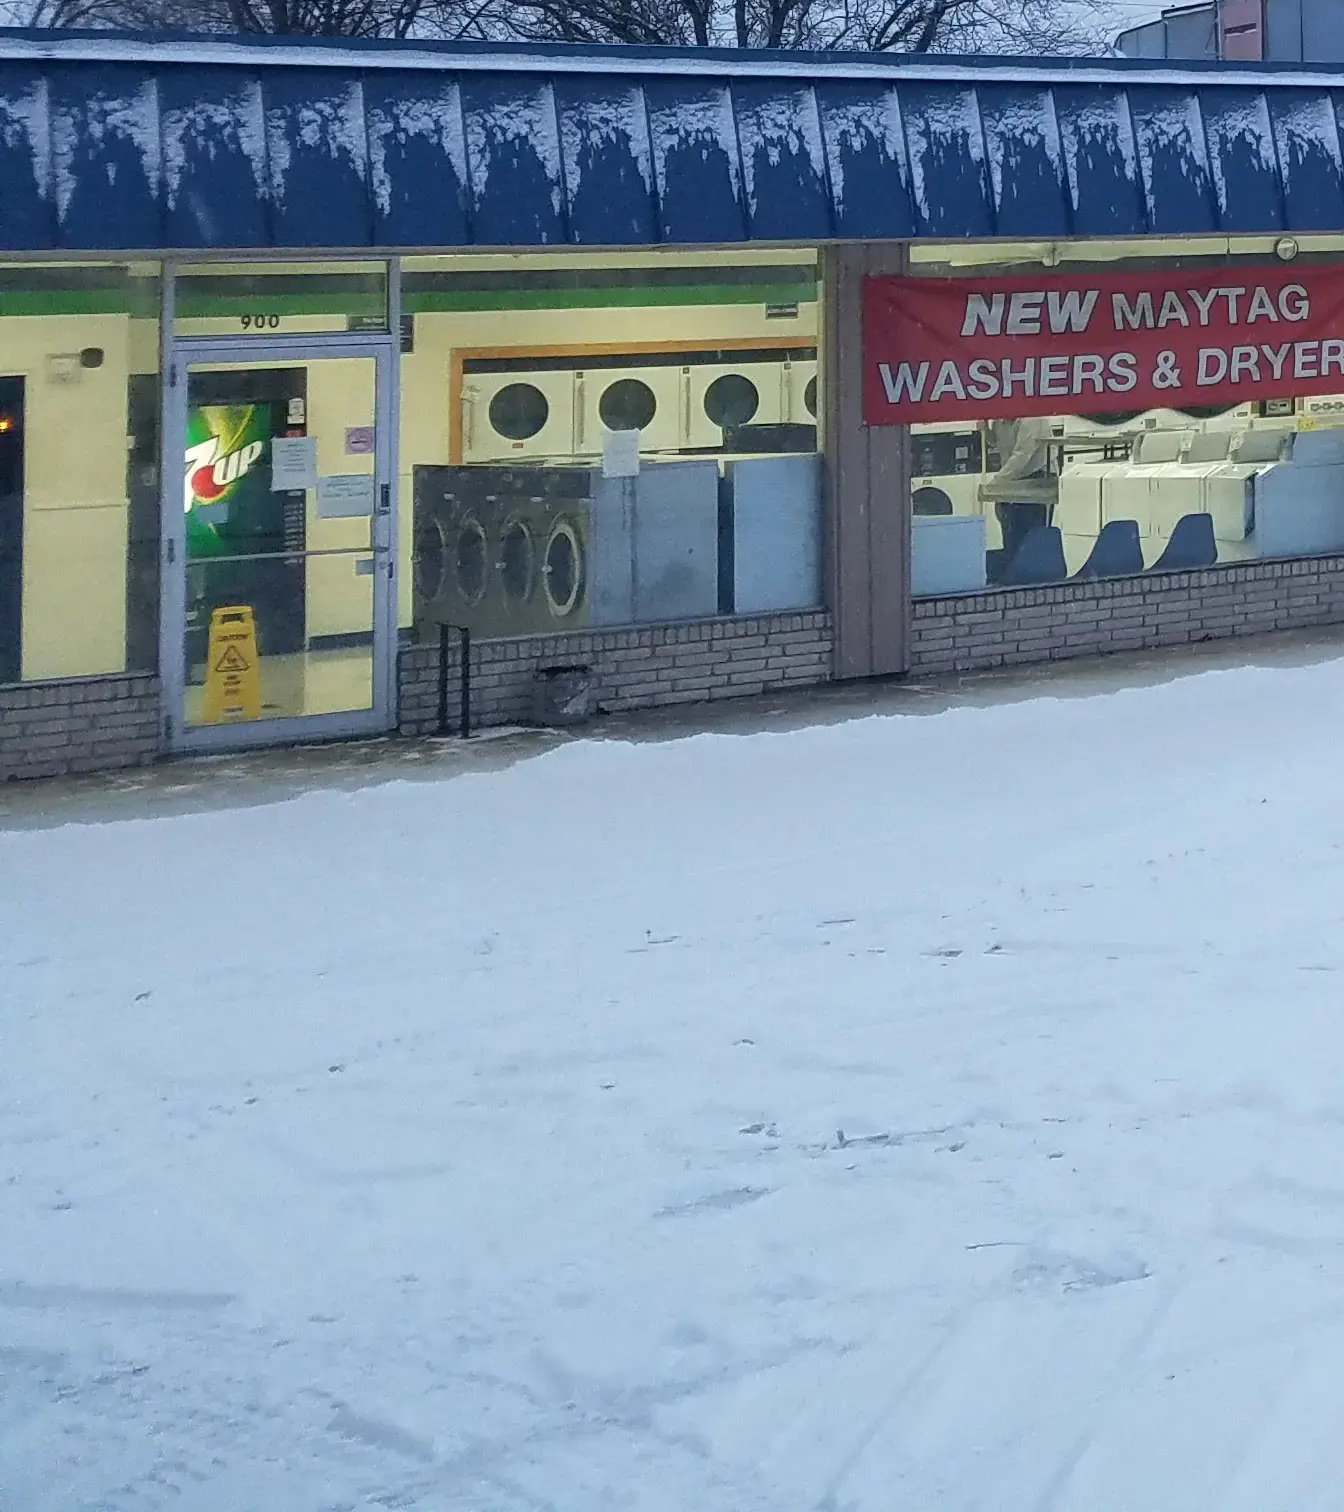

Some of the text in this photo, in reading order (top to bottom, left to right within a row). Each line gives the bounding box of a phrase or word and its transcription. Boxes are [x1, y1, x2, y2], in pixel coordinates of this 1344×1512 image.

[240, 313, 280, 330] 900
[960, 284, 1310, 337] NEW MAYTAG
[878, 351, 1138, 405] WASHERS
[1151, 349, 1182, 389] &
